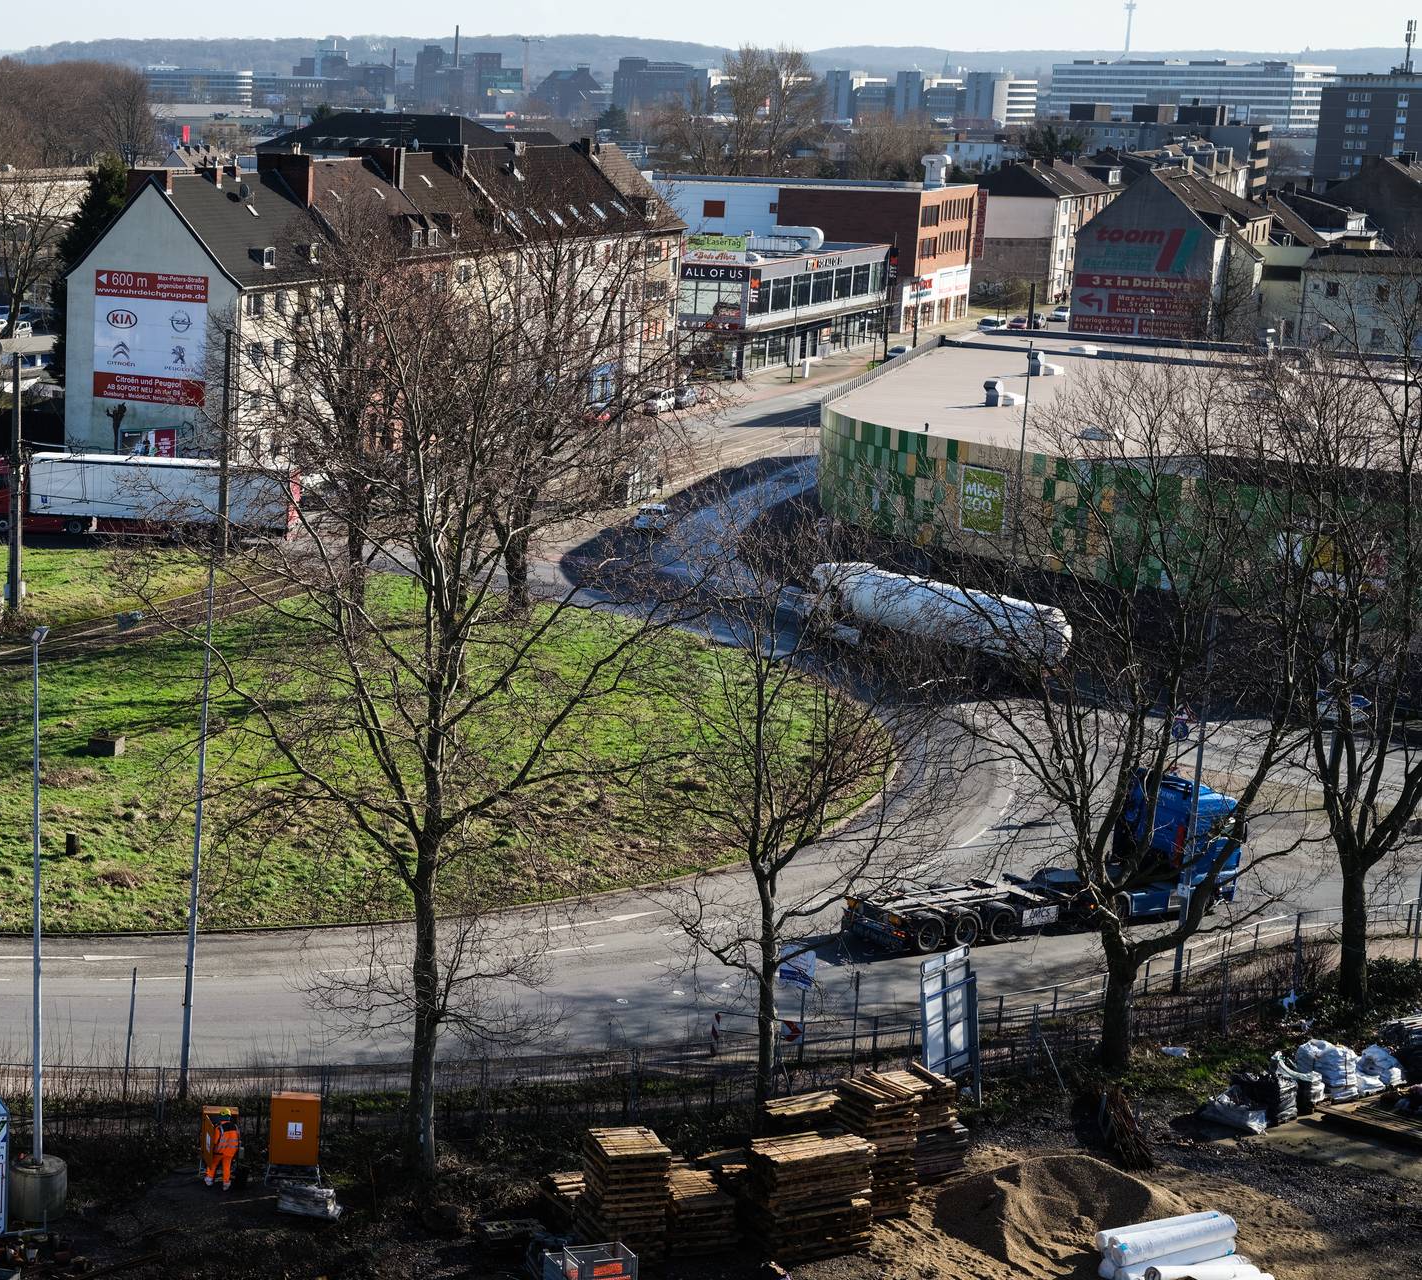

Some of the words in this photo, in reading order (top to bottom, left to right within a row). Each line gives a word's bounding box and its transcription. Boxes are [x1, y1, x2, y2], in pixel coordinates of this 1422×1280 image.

[1096, 226, 1166, 243] toom
[686, 268, 705, 277] ALL
[709, 269, 725, 278] OF
[729, 270, 743, 279] US
[112, 273, 133, 287] 600
[137, 277, 147, 288] m
[1092, 276, 1100, 286] 3
[1104, 278, 1113, 286] x
[1117, 277, 1128, 287] in
[1133, 278, 1193, 292] Duisburg
[157, 283, 184, 291] gegenüber
[97, 287, 206, 300] www.ruhrdeichgruppe.de
[112, 313, 132, 325] KIA
[115, 375, 139, 384] Citroën
[140, 377, 153, 385] und
[116, 384, 140, 392] SOFORT
